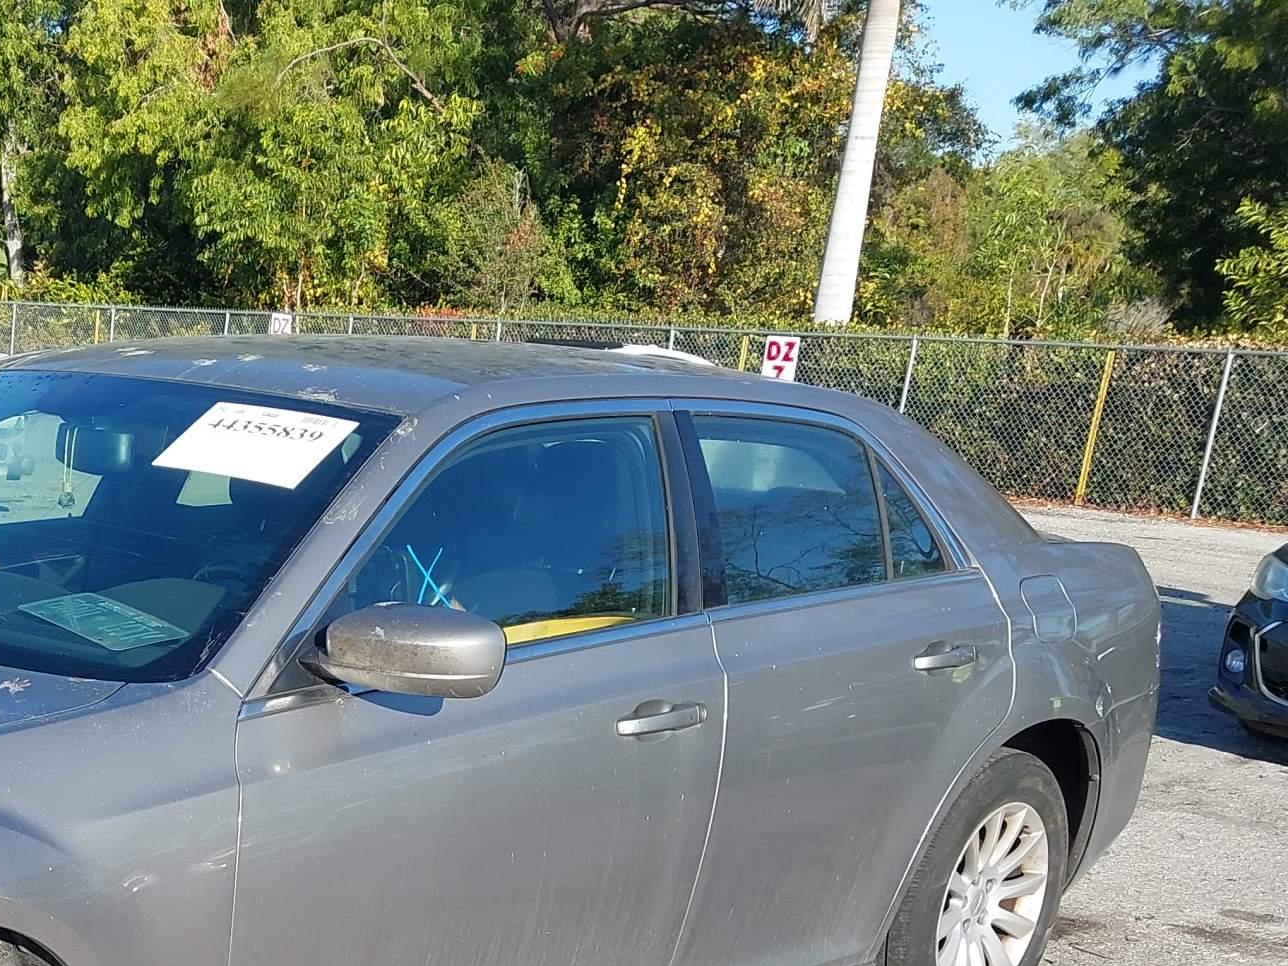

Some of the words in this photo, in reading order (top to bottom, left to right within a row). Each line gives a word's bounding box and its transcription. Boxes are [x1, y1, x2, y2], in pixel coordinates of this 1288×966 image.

[767, 341, 796, 362] DZ
[772, 365, 785, 378] 7
[208, 418, 323, 441] 44355839
